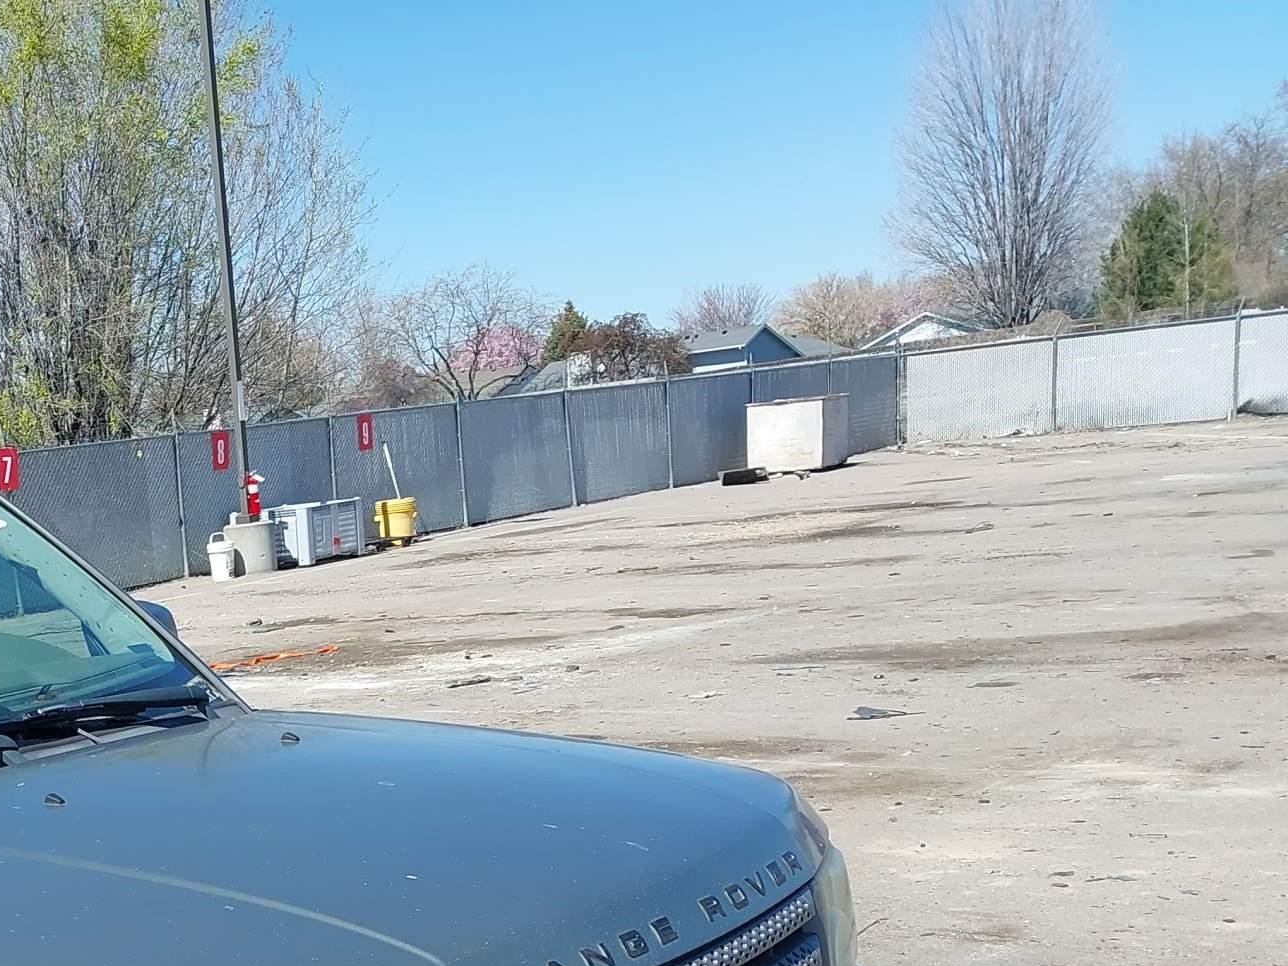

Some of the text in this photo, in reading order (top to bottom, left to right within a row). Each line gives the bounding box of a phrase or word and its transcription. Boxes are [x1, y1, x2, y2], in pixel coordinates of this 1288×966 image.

[362, 422, 369, 445] 9
[217, 439, 225, 465] 8
[2, 456, 12, 484] 7
[697, 850, 803, 923] ROVER
